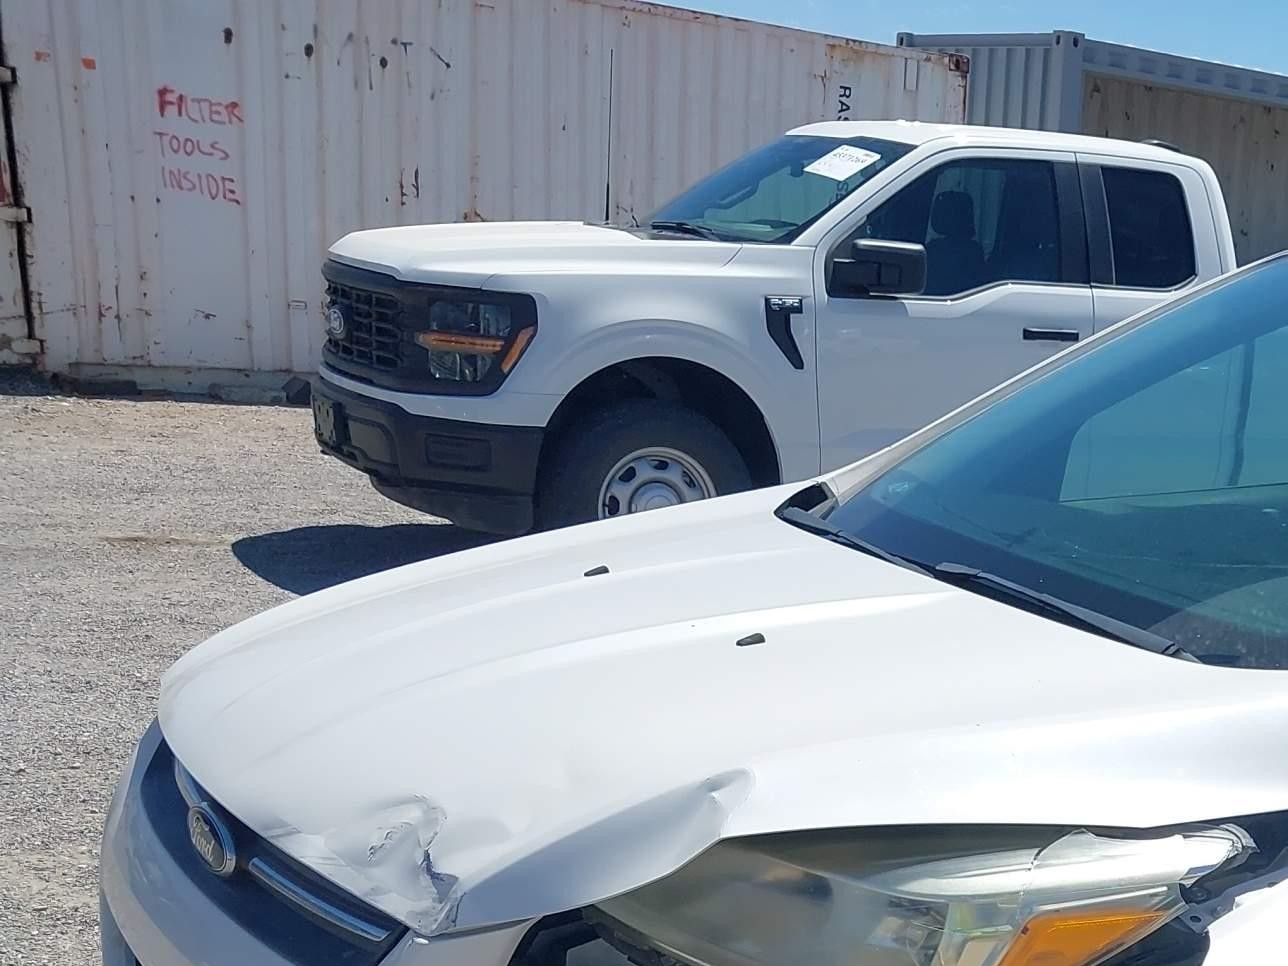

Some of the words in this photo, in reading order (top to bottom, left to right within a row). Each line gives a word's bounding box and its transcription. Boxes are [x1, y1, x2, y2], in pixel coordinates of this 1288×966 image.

[157, 86, 244, 125] FILTER
[153, 131, 230, 161] TOOLS
[161, 166, 242, 205] INSIDE
